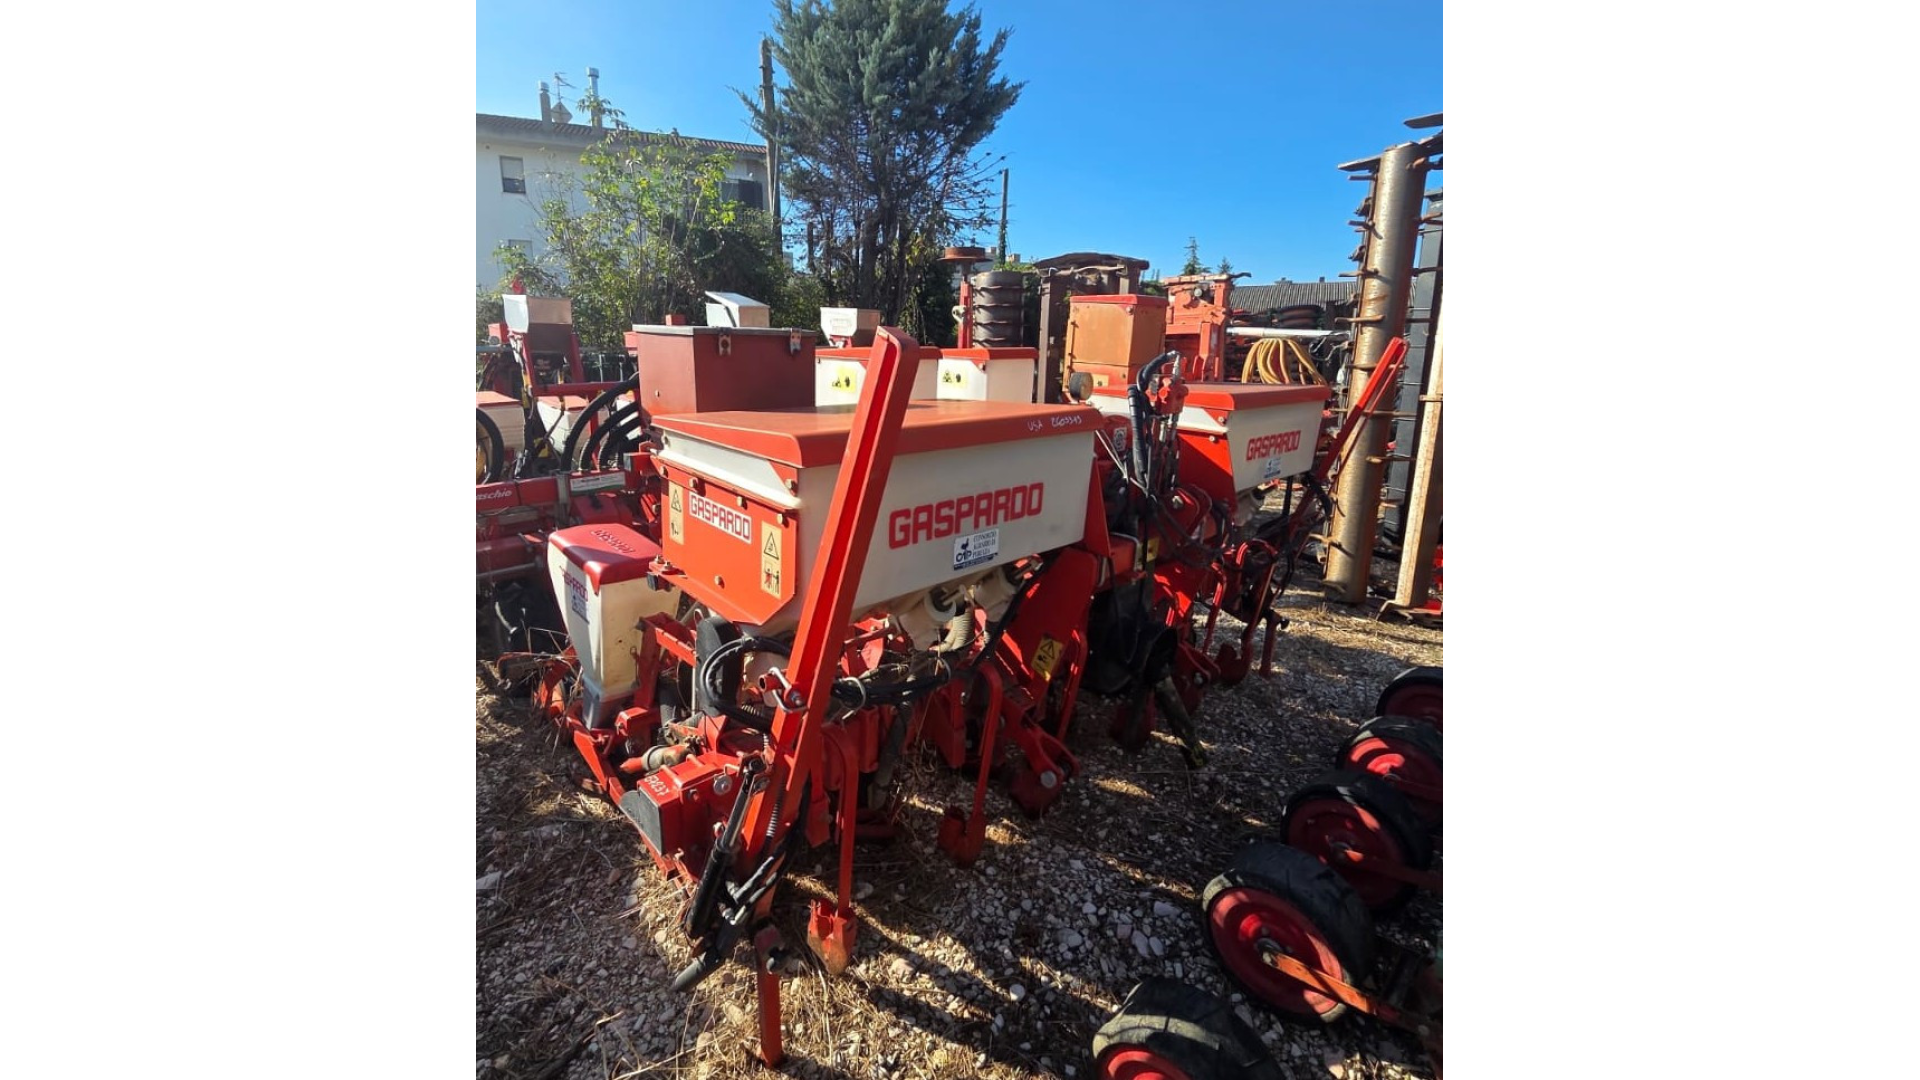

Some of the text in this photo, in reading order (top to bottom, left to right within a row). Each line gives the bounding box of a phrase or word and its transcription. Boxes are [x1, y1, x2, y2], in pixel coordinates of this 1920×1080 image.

[1246, 430, 1301, 462] GASPARDO
[690, 494, 750, 541] GASPARDO
[889, 482, 1044, 550] GASPARDO
